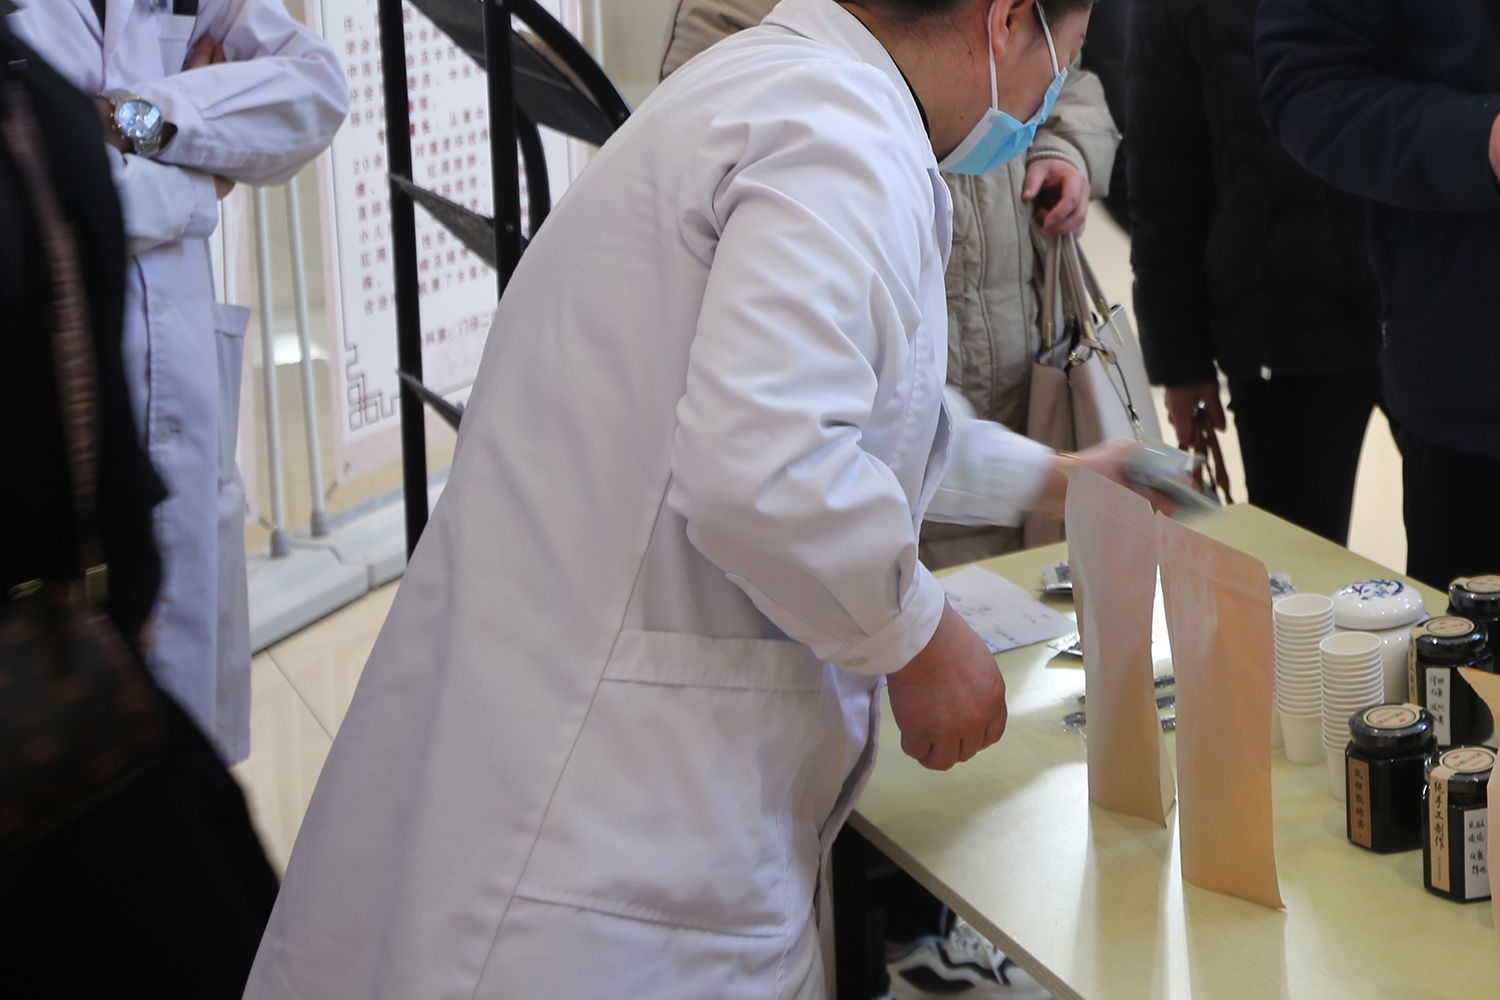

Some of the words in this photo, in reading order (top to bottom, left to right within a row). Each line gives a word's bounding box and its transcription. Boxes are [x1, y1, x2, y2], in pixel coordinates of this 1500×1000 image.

[1434, 780, 1446, 851] 纯手工制作
